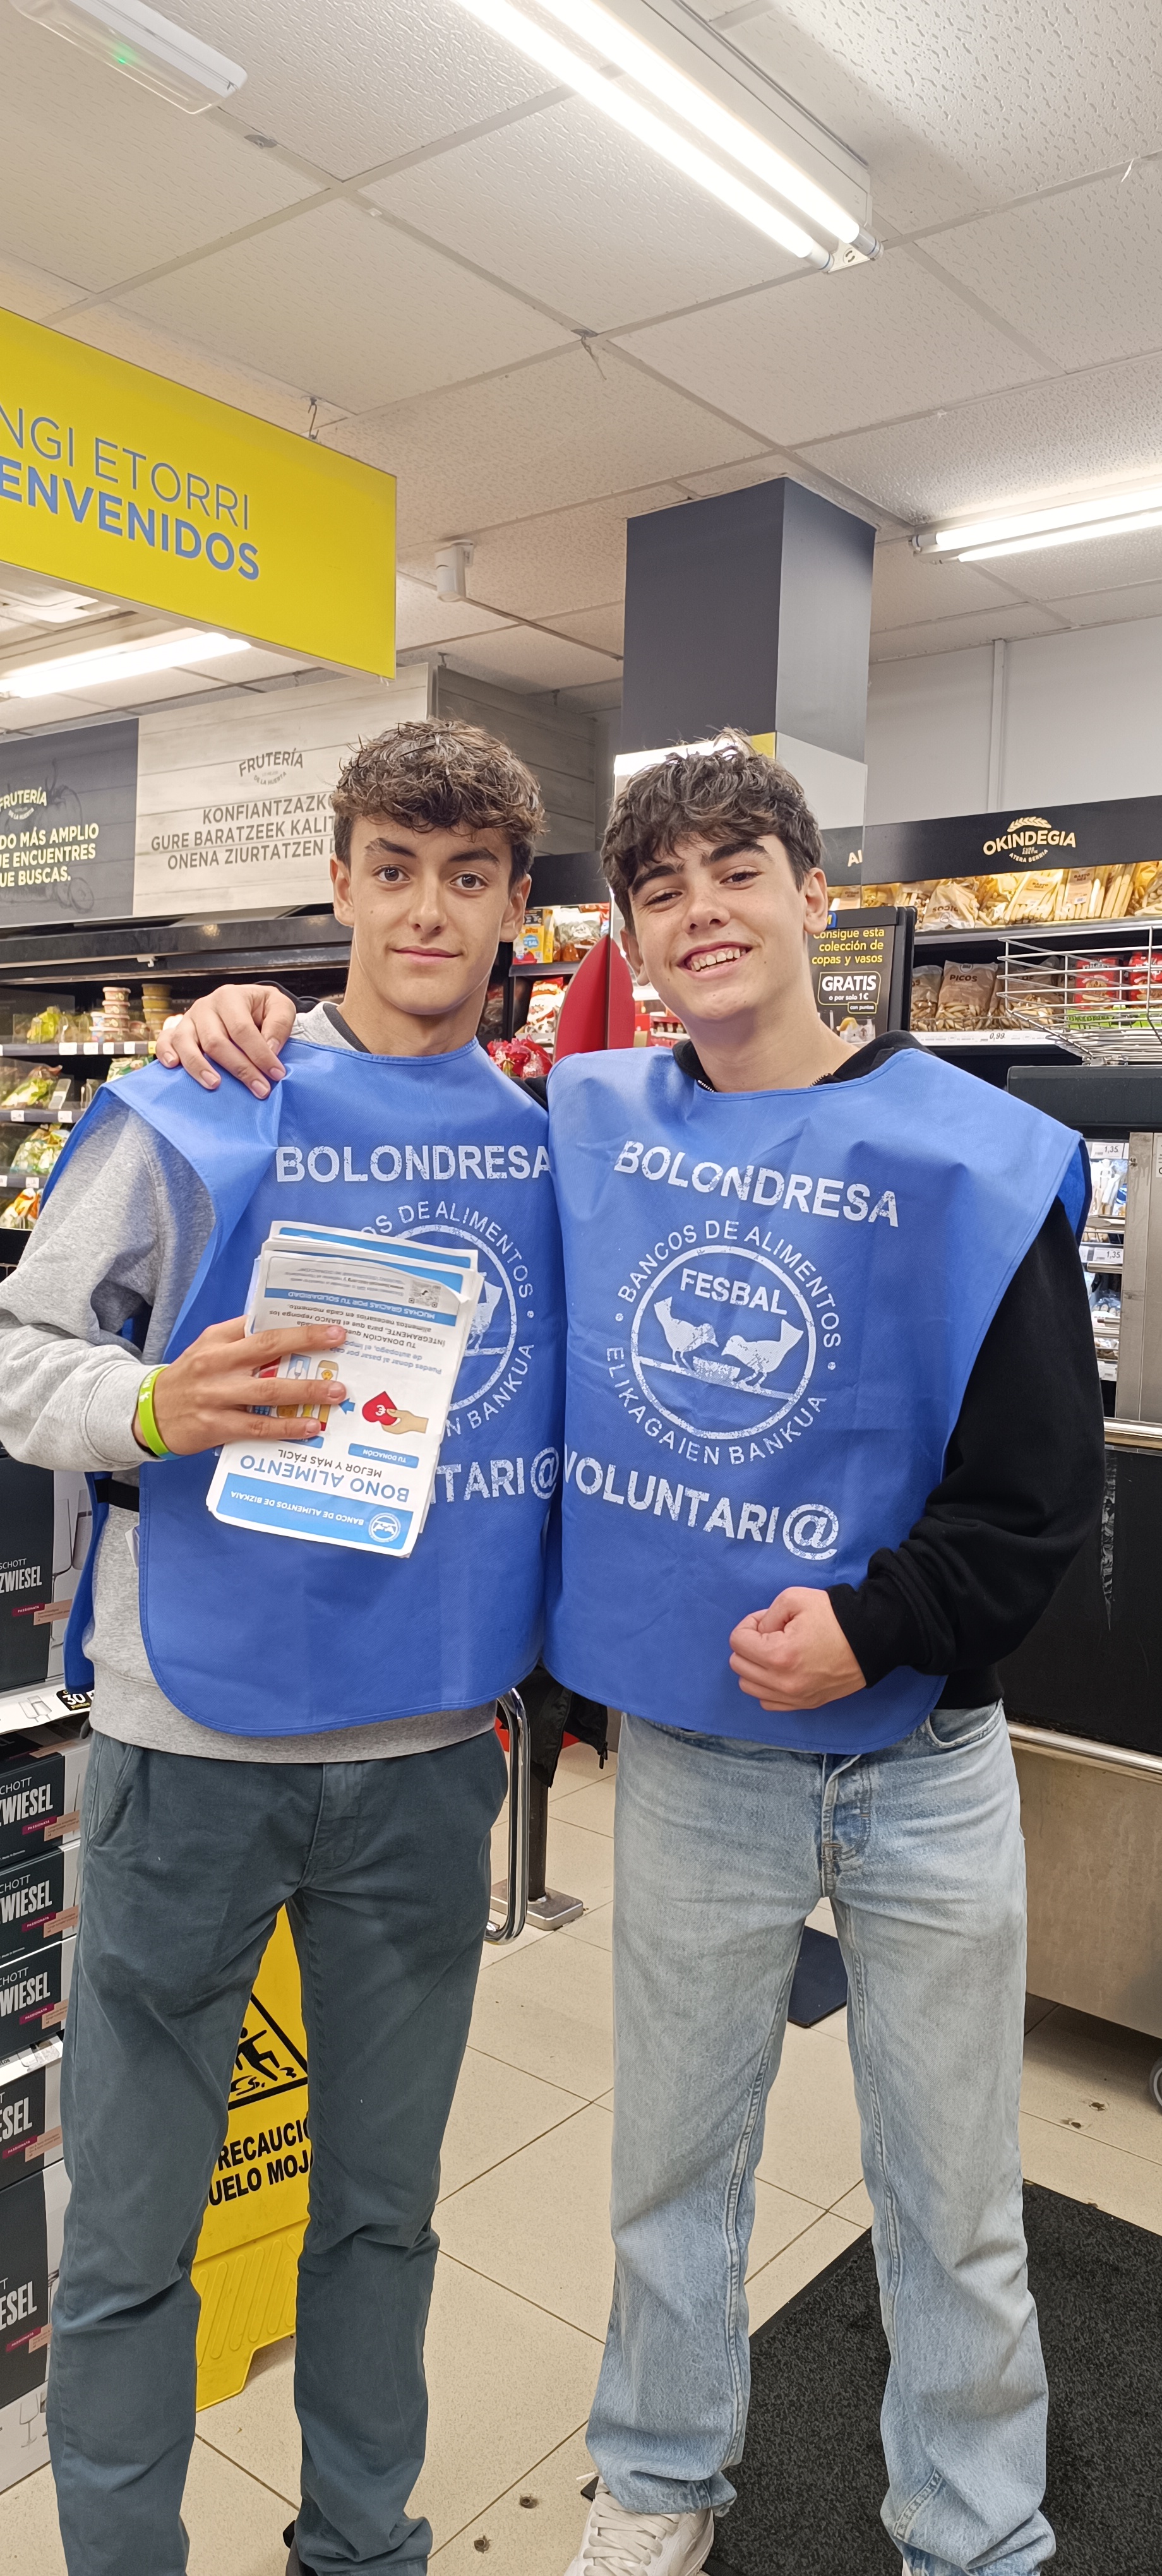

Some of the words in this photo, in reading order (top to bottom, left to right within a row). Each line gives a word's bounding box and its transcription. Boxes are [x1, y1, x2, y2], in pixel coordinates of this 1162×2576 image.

[95, 437, 248, 530] ETORRI
[0, 456, 259, 580] ENVENIDOS
[239, 748, 302, 777] FRUTERÍA
[20, 826, 46, 847] MÁS
[49, 823, 99, 844] AMPLIO
[152, 832, 189, 851] GURE
[194, 821, 285, 847] BARATZEEK
[983, 830, 1076, 856] OKINDEGIA
[13, 843, 96, 868] ENCUENTRES
[167, 850, 219, 870] ONENA
[225, 839, 323, 864] ZIURTATZEN
[18, 866, 71, 886] BUSCAS.
[863, 927, 884, 938] esta
[819, 940, 866, 951] colección
[870, 939, 883, 950] de
[812, 956, 841, 967] copas
[844, 956, 851, 966] y
[855, 955, 883, 963] vasos
[822, 975, 877, 991] GRATIS
[949, 974, 978, 982] PICOS
[1105, 1146, 1119, 1154] 1,35
[275, 1145, 551, 1183] BOLONDRESA
[613, 1140, 899, 1227] BOLONDRESA
[398, 1201, 431, 1224] DE
[435, 1201, 533, 1298] ALIMENTOS
[1106, 1251, 1121, 1259] 1,35
[617, 1224, 697, 1303] BANCOS
[705, 1220, 740, 1240] DE
[744, 1225, 841, 1349] ALIMENTOS
[680, 1268, 788, 1315] FESBAL
[315, 1316, 341, 1325] BANCO
[352, 1321, 365, 1329] que
[345, 1340, 364, 1350] impo
[363, 1333, 405, 1347] DONACIÓN
[467, 1344, 534, 1429] BANKUA
[606, 1347, 719, 1465] ELIKAGAIEN
[729, 1396, 827, 1465] BANKUA
[278, 1449, 308, 1463] FÁCIL
[310, 1455, 333, 1467] MÁS
[335, 1462, 342, 1470] Y
[362, 1448, 397, 1462] DONACIÓN
[240, 1455, 345, 1488] ALIMENTO
[345, 1464, 382, 1478] MEJOR
[431, 1446, 559, 1505] TARI@
[231, 1491, 262, 1503] BIZKAIA
[350, 1477, 410, 1503] BONO
[264, 1498, 275, 1506] DE
[277, 1501, 322, 1516] ALIMENTOS
[564, 1443, 839, 1560] VOLUNTARI@
[323, 1510, 334, 1518] DE
[336, 1513, 364, 1526] BANCO
[63, 1693, 86, 1705] 30
[0, 1784, 53, 1826] WIESEL
[0, 1880, 52, 1924] WIESEL
[217, 2116, 310, 2171] RECAUCI
[209, 2168, 262, 2206] UELO
[267, 2149, 314, 2185] MOJ
